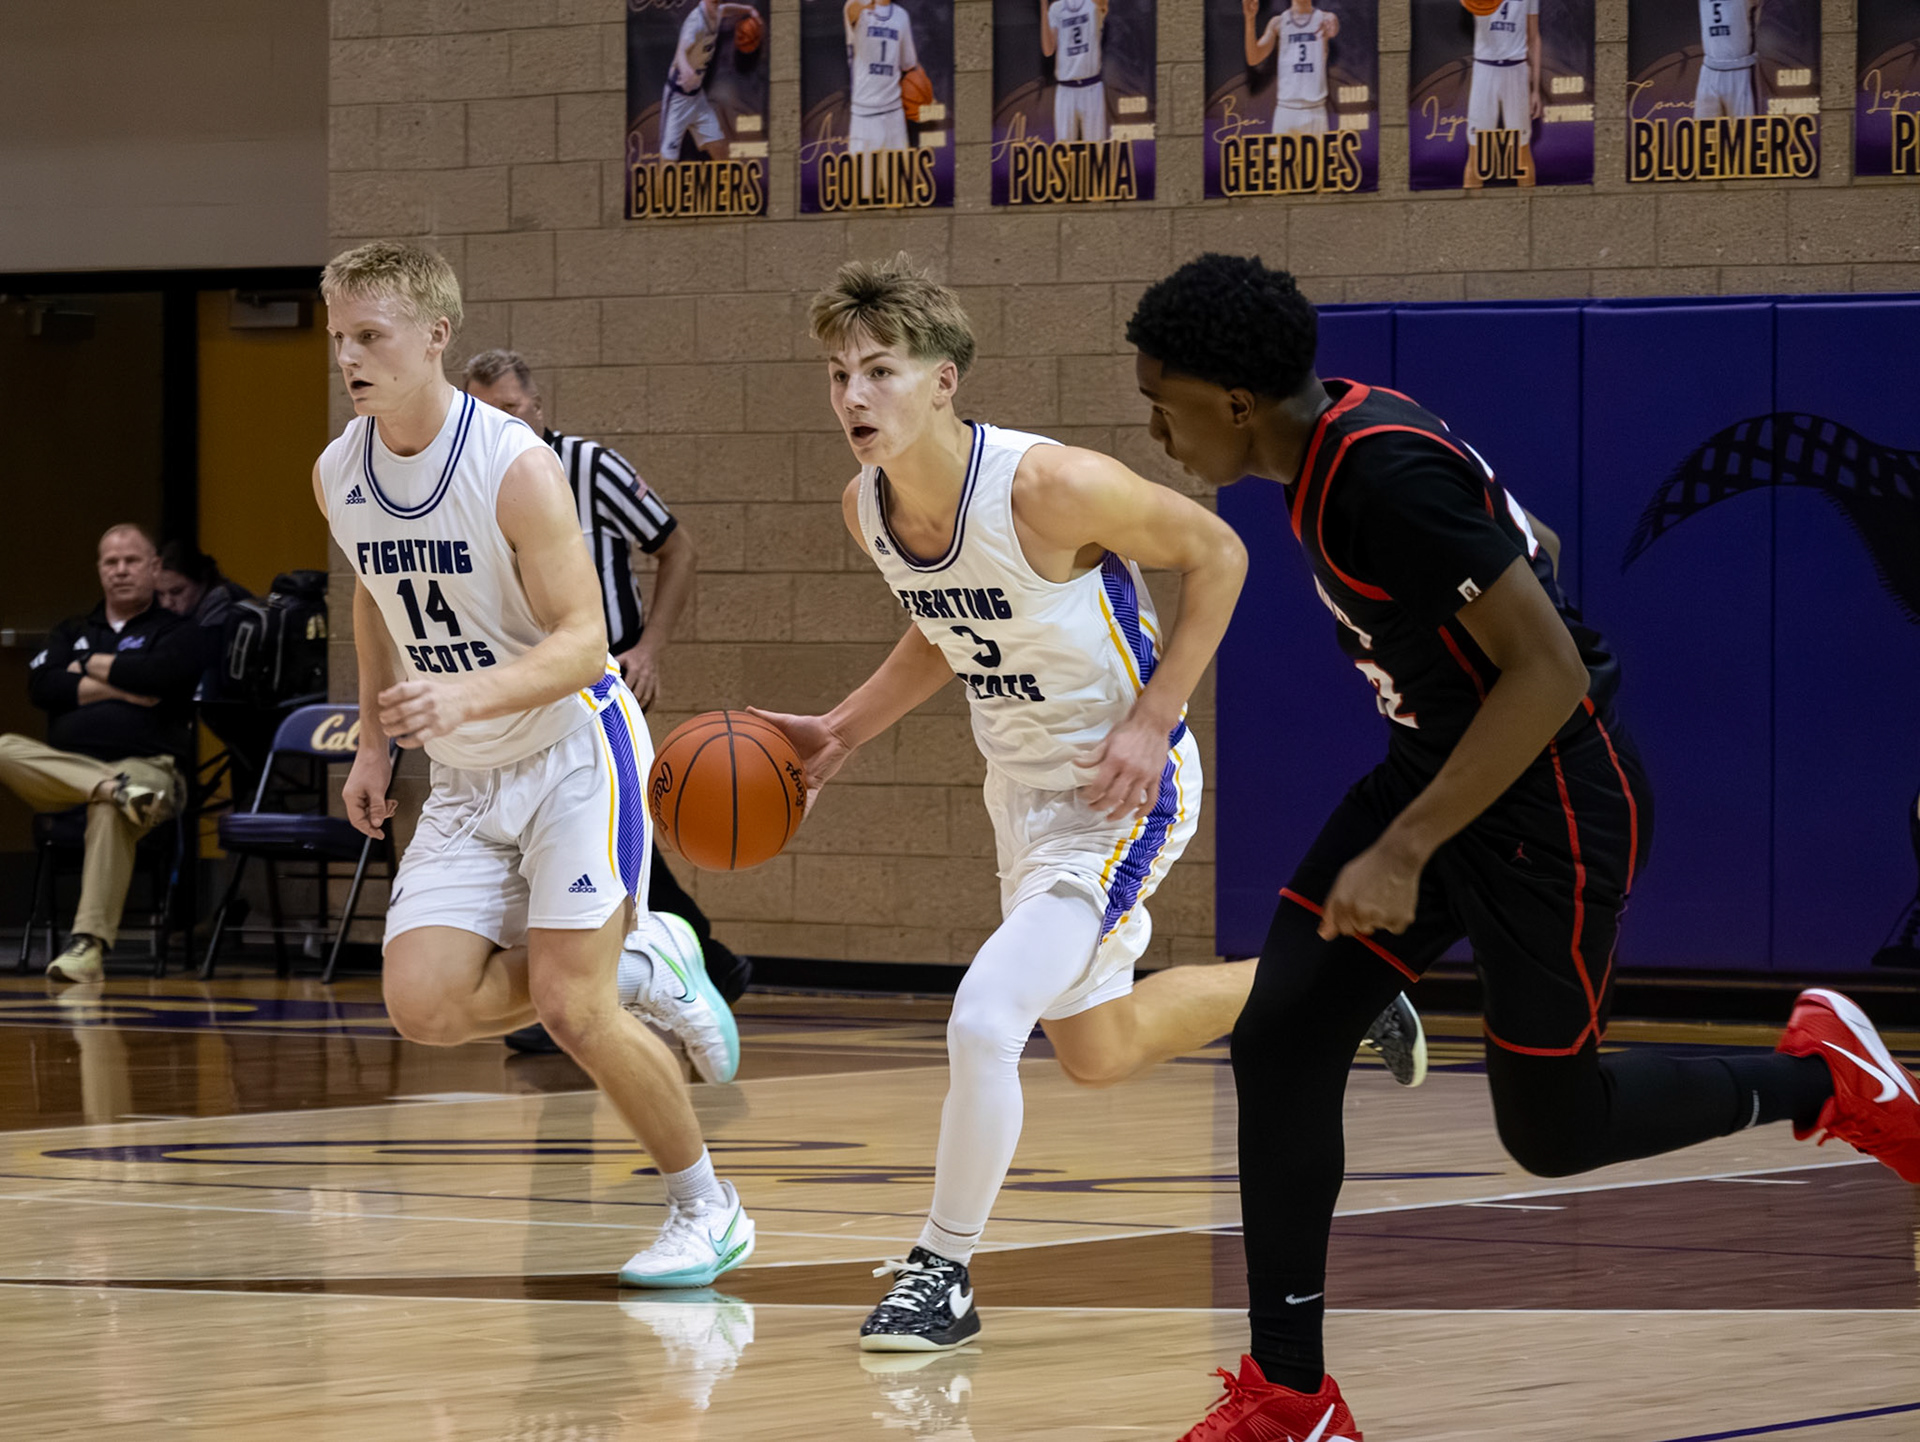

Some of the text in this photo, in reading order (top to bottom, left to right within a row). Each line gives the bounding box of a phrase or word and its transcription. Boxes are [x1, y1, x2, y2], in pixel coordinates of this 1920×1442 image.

[1713, 3, 1722, 23] 5
[1009, 138, 1137, 204] POSTMA
[1221, 129, 1362, 197] GEERDES
[1475, 128, 1529, 180] UYL
[1631, 114, 1817, 181] BLOEMERS
[632, 159, 763, 218] BLOEMERS
[818, 146, 936, 211] COLLINS
[356, 539, 473, 575] FIGHTING
[396, 578, 462, 639] 14
[897, 588, 1012, 620] FIGHTING
[405, 640, 497, 673] SCOTS
[950, 625, 1001, 668] 3
[568, 884, 597, 893] adidas
